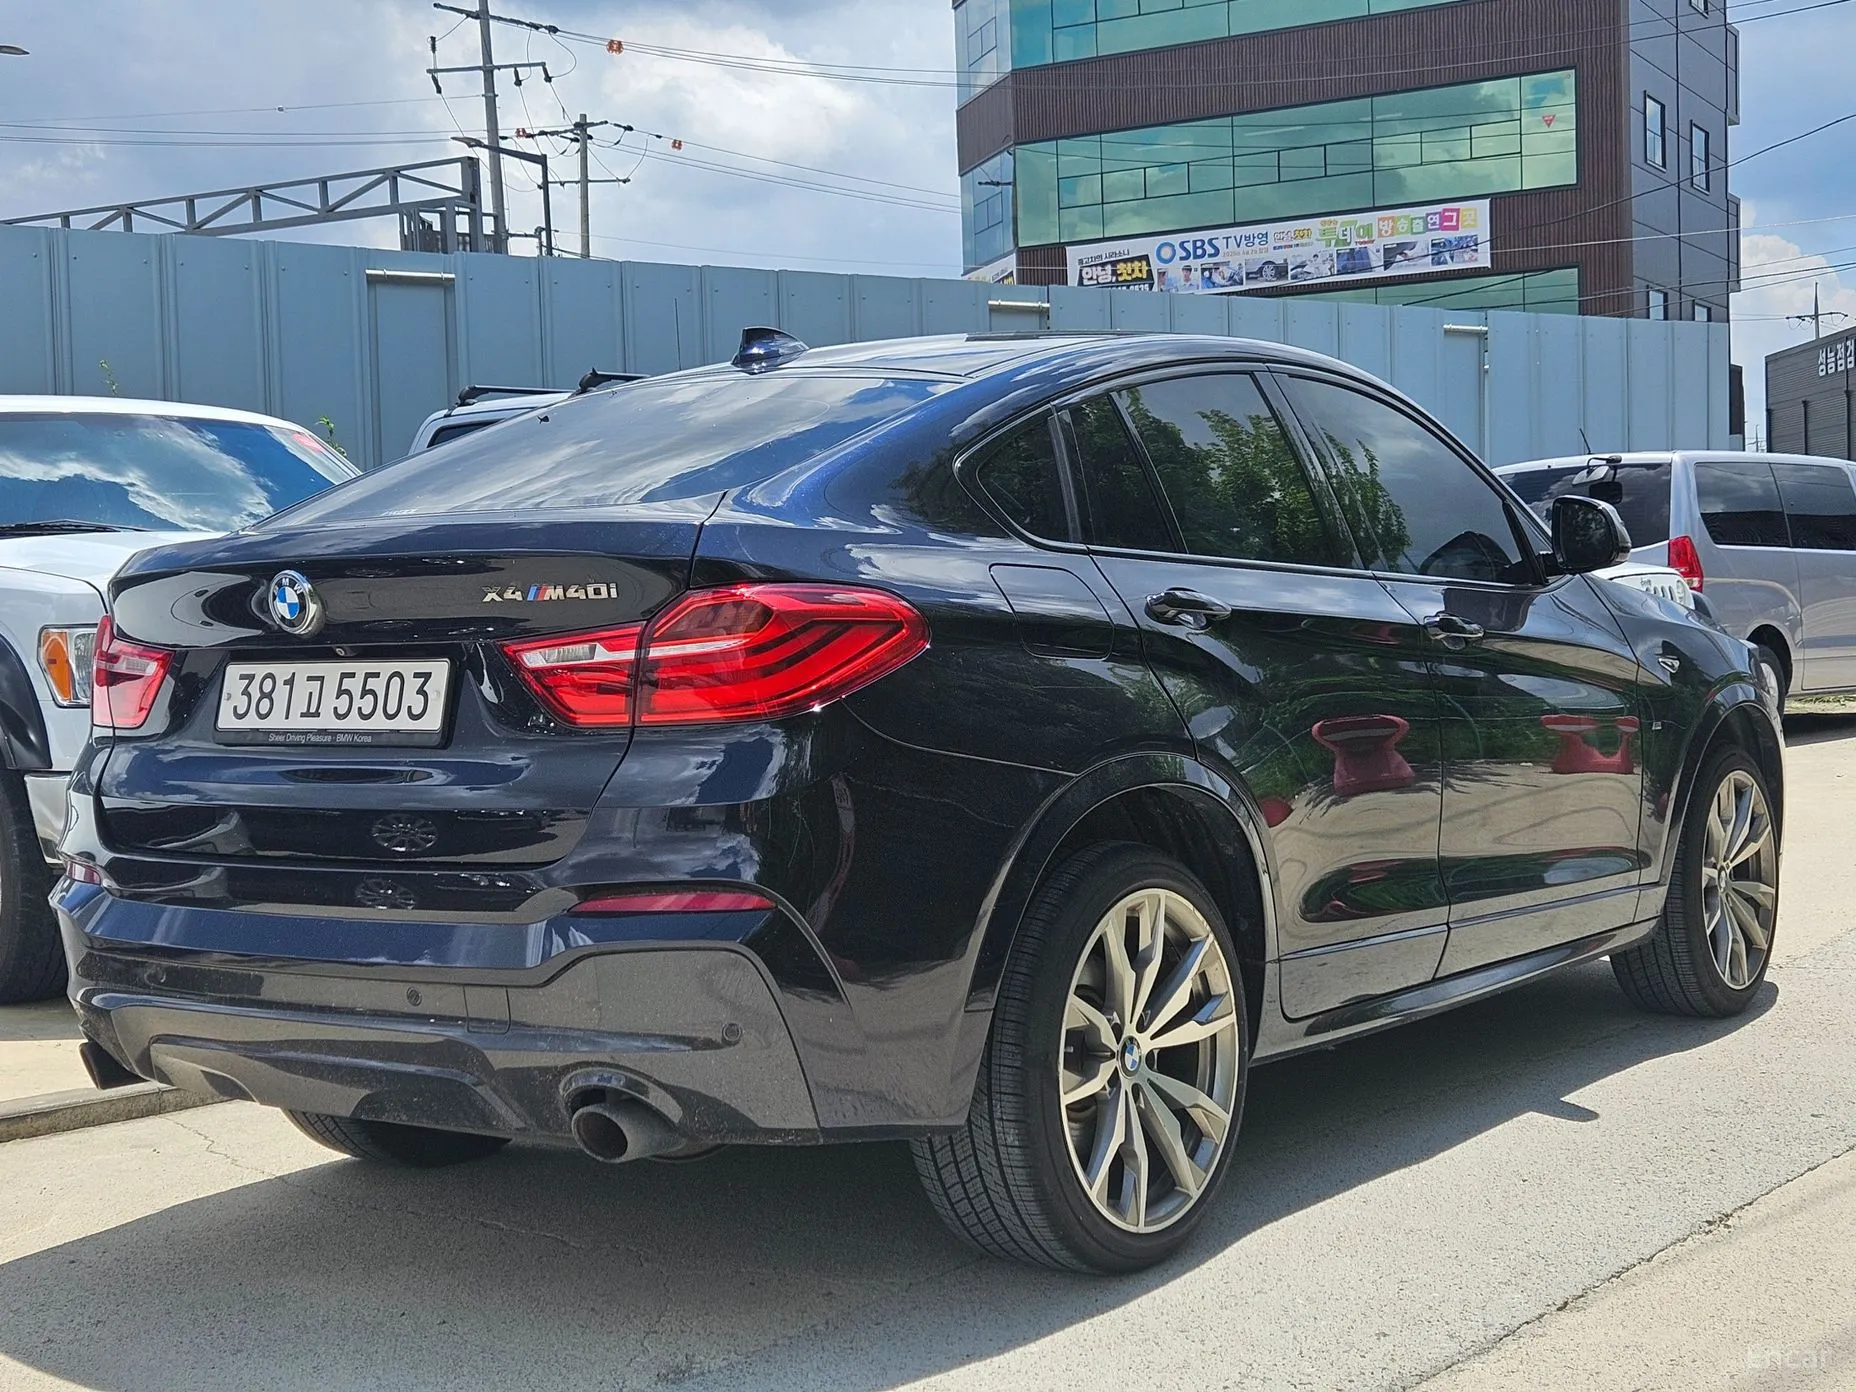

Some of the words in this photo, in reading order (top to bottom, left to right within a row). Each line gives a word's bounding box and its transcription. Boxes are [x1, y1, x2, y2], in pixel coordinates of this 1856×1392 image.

[1179, 237, 1220, 261] SBS
[1081, 263, 1116, 285] 안녕,
[1117, 260, 1149, 281] 첫차
[482, 584, 523, 602] X4
[542, 582, 618, 602] M40i
[332, 670, 433, 721] 5503
[268, 732, 286, 741] Sheer
[286, 732, 306, 743] Driving
[306, 733, 331, 742] Pleasure
[336, 733, 354, 742] BMW
[354, 733, 372, 743] Korea
